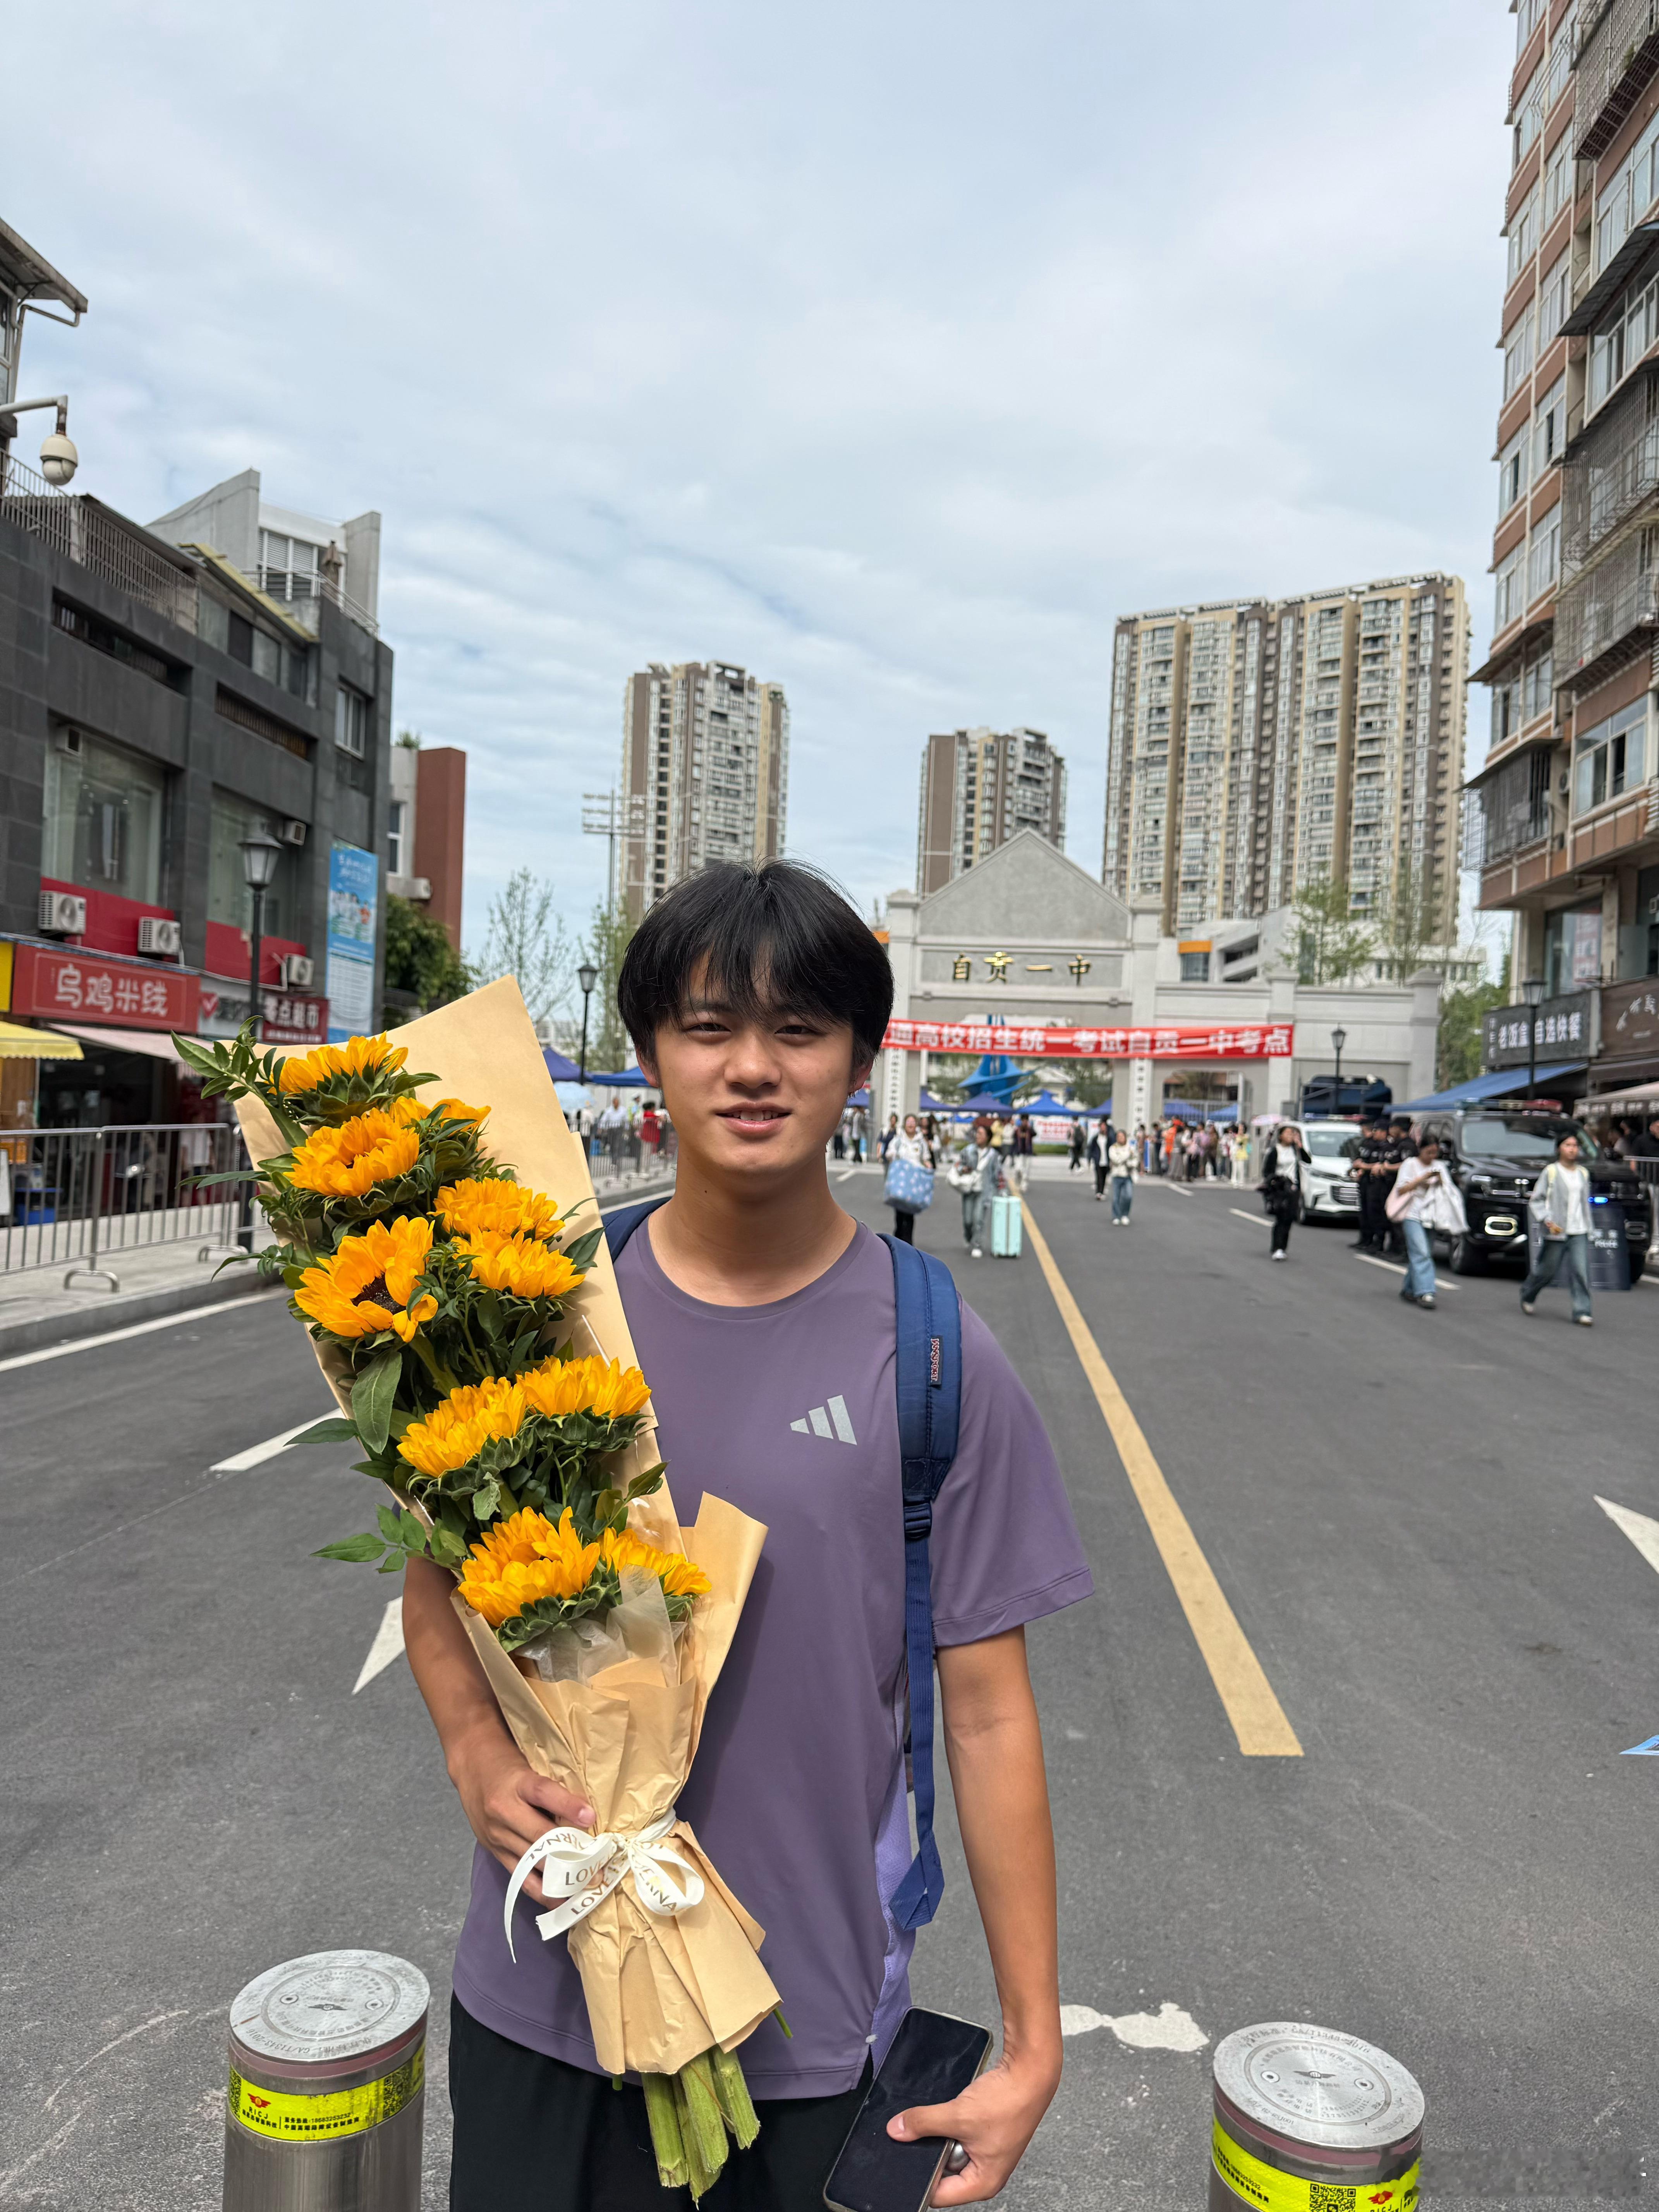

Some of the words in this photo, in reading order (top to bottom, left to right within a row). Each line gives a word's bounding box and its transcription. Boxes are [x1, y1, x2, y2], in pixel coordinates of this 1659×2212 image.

[952, 951, 1091, 986] 自贡一中
[55, 963, 168, 1013] 乌鸡米线
[883, 1022, 1290, 1054] 通高校招生统一考试自贡一中考点
[931, 1338, 939, 1381] JANSPORT
[249, 2106, 268, 2119] RICJ
